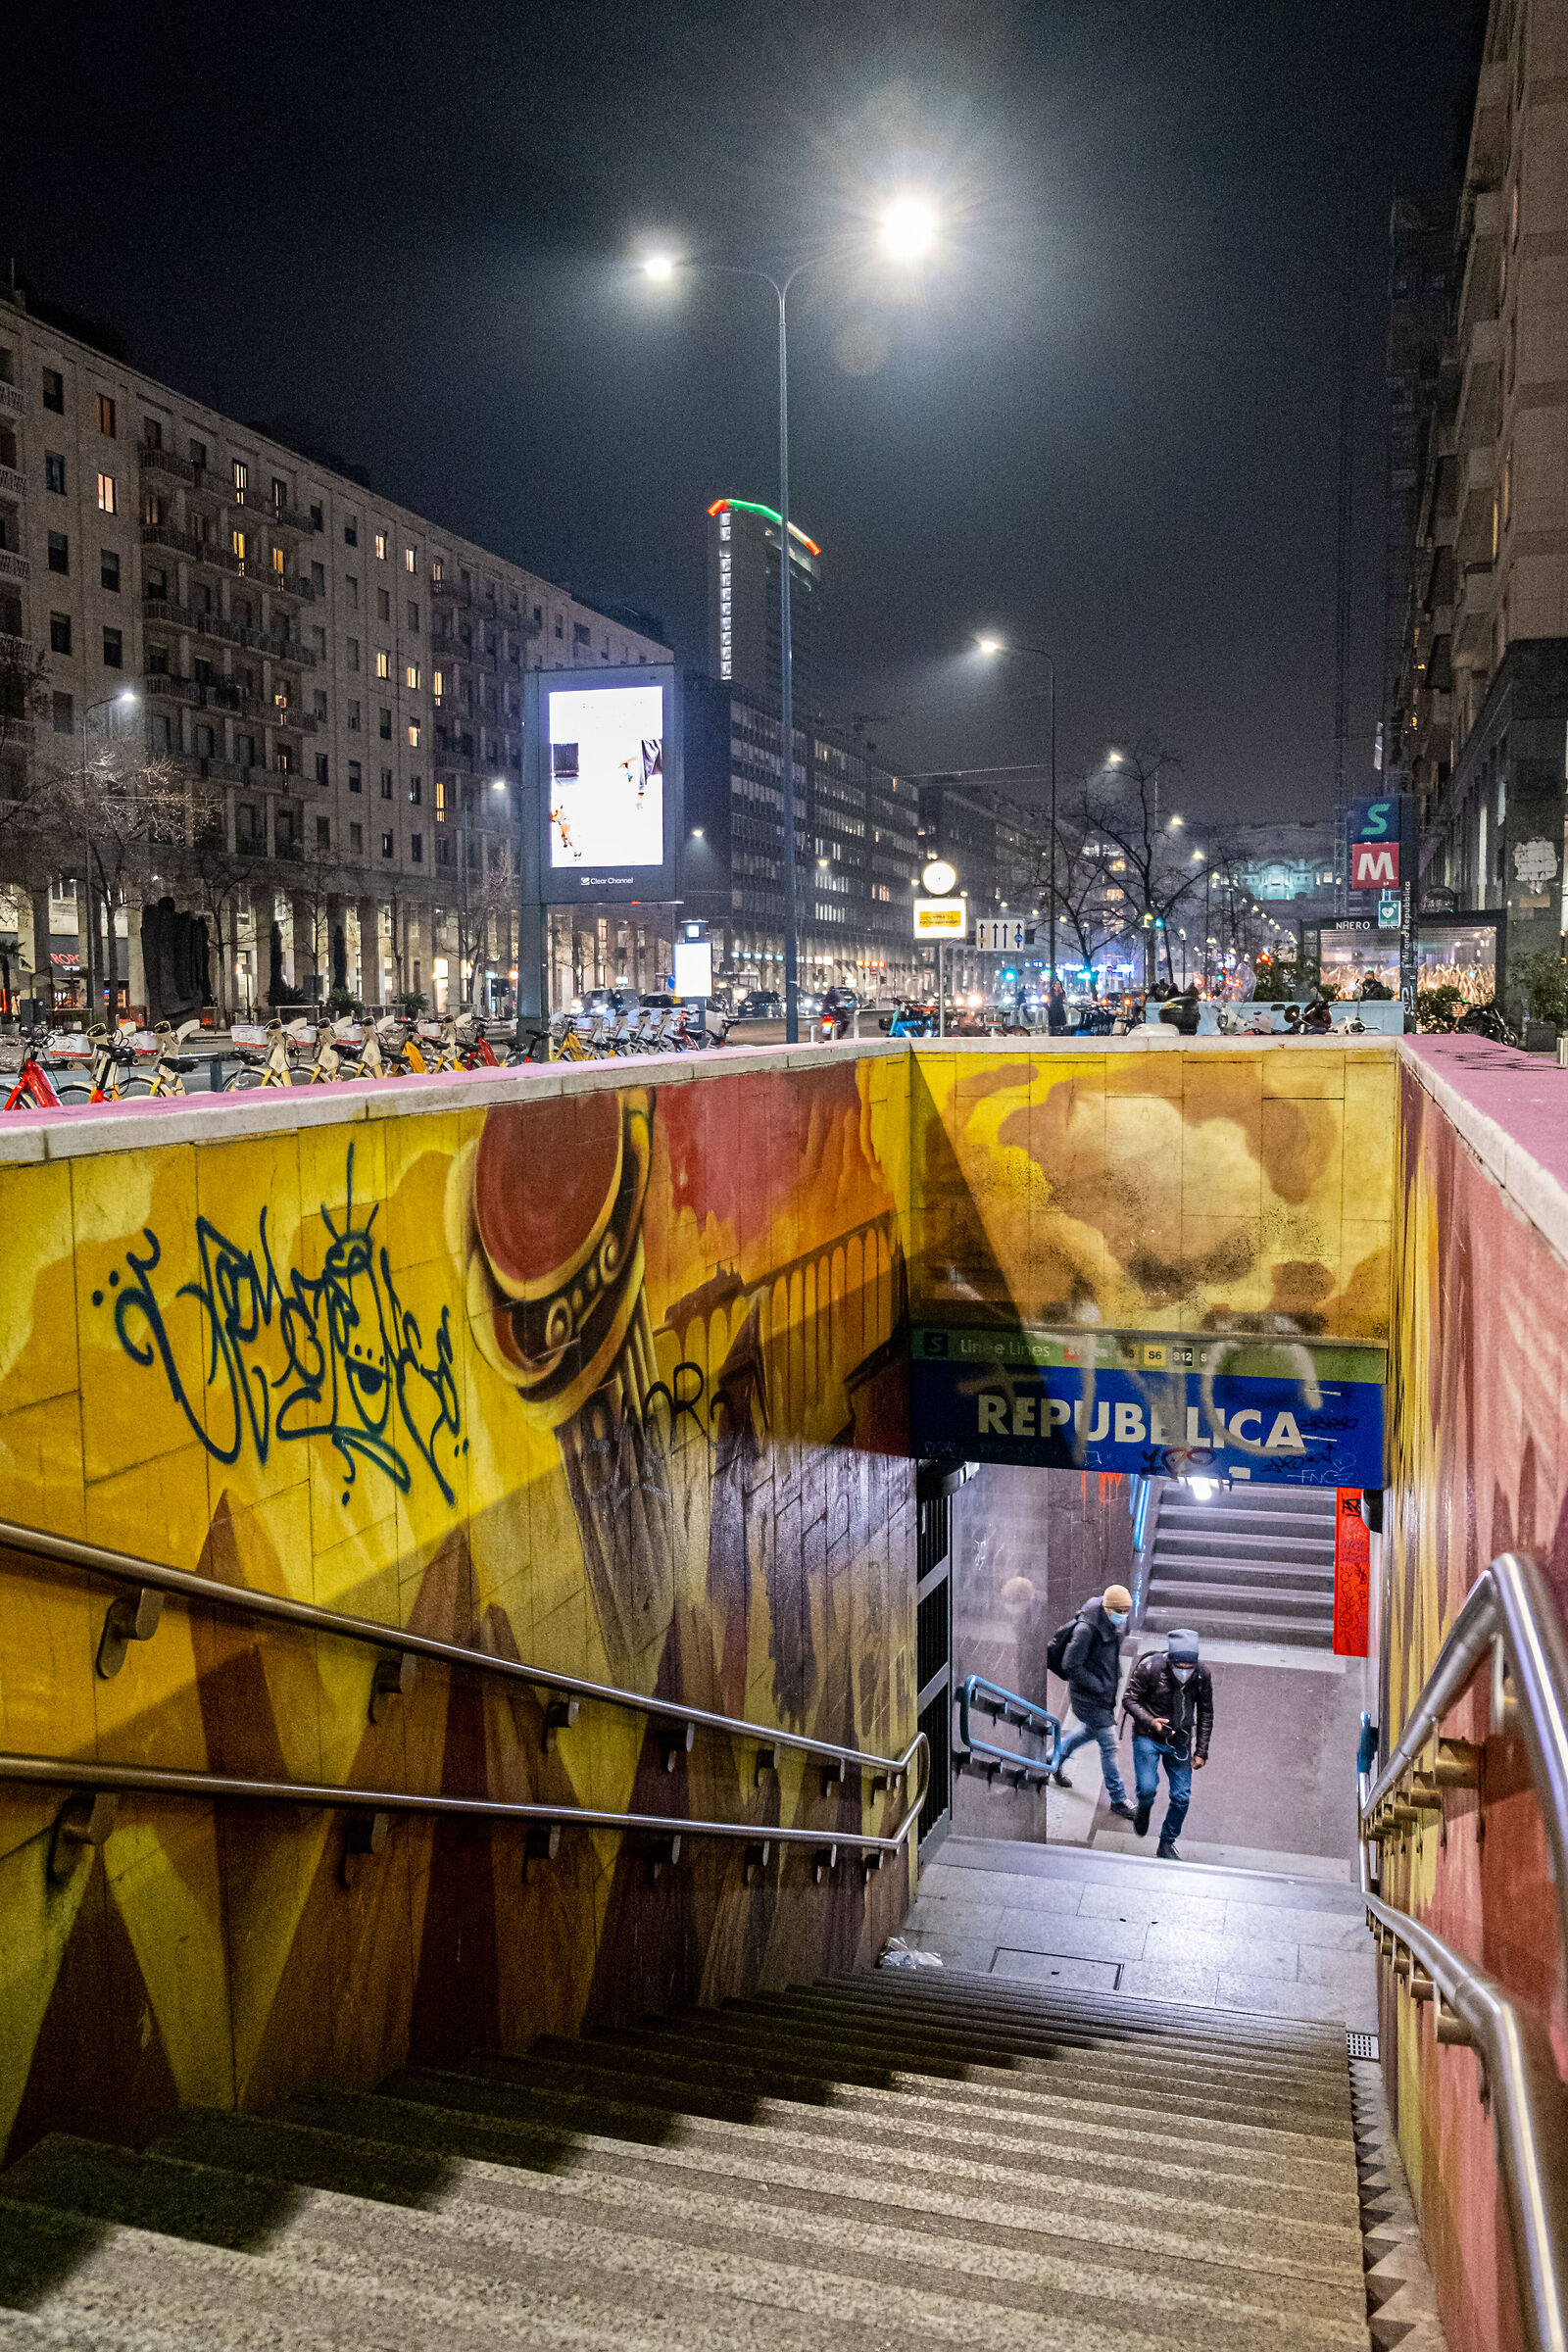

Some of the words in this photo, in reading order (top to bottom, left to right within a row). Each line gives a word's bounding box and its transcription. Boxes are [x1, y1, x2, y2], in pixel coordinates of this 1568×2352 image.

[1361, 804, 1391, 835] S
[1357, 852, 1395, 880] M
[1402, 881, 1412, 930] Repubblica
[960, 1340, 1004, 1354] Line
[1009, 1341, 1051, 1357] Lines
[1173, 1352, 1193, 1361] S12
